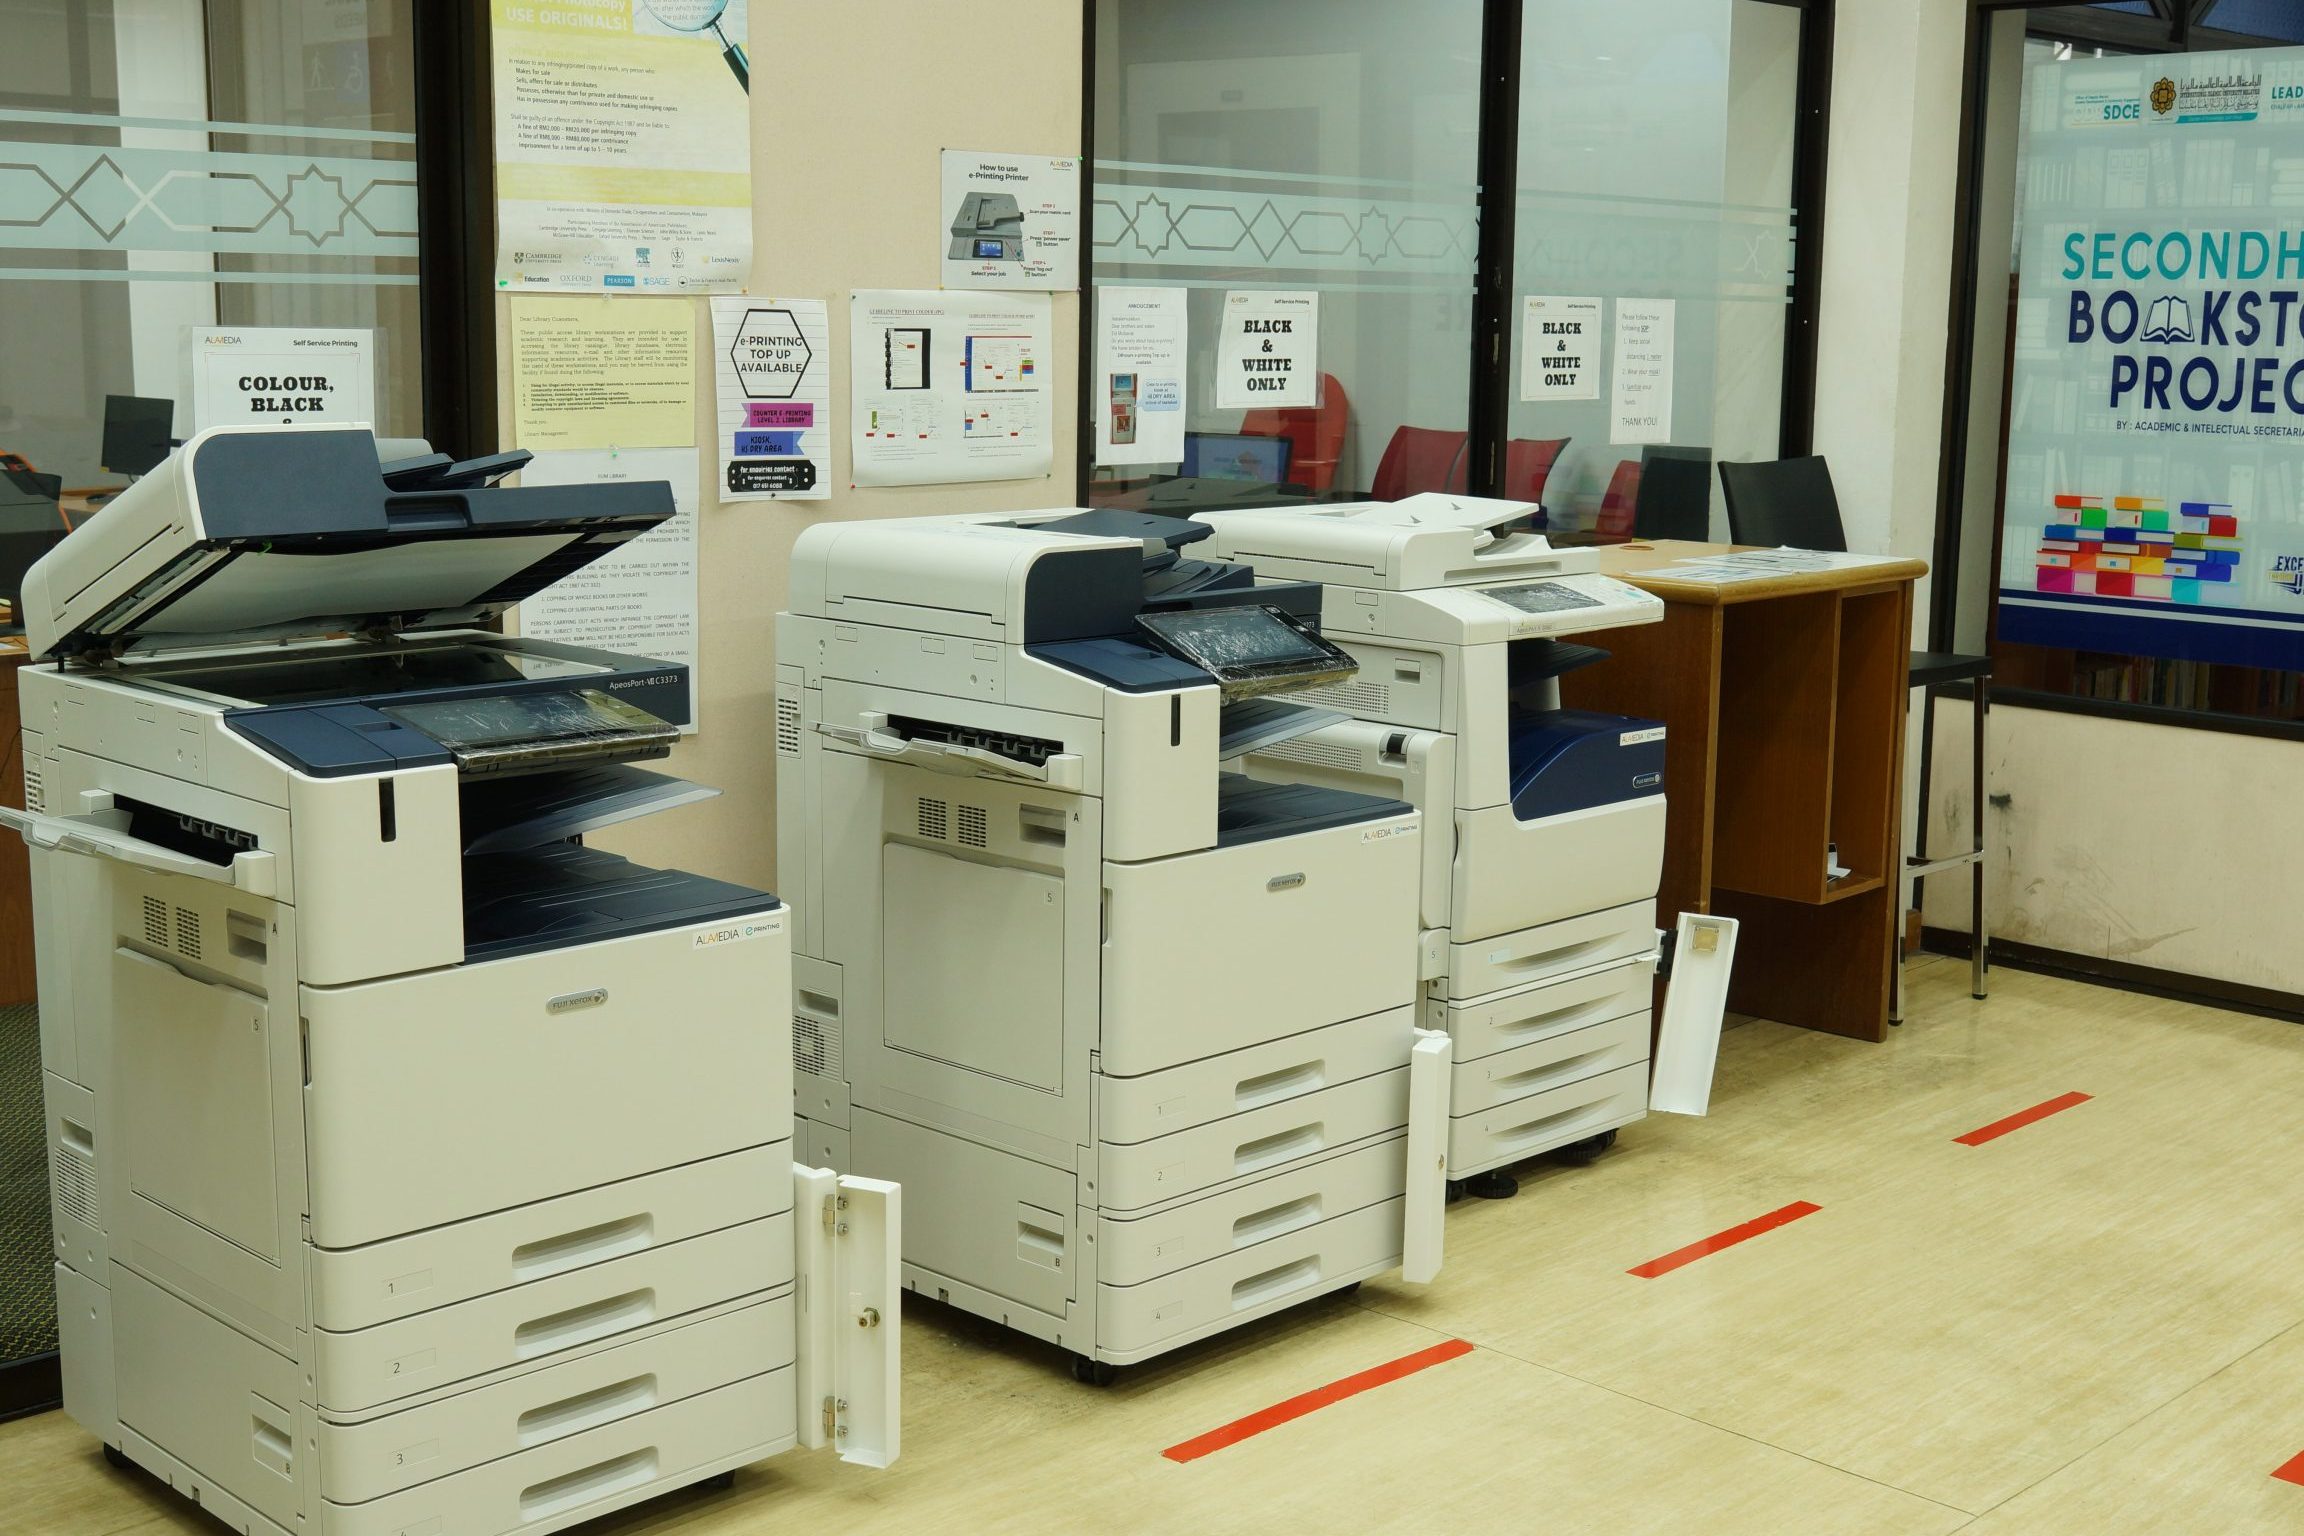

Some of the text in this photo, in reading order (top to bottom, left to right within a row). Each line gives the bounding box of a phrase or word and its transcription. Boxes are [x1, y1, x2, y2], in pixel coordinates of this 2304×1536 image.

[507, 7, 627, 31] USE ORIGINALS!
[620, 103, 638, 111] making
[639, 104, 662, 112] infringing
[2104, 104, 2140, 119] SDCE
[980, 164, 996, 172] How
[969, 173, 1004, 181] e-Printing
[650, 277, 670, 285] SAGE
[1243, 320, 1292, 333] BLACK
[1542, 323, 1582, 334] BLACK
[205, 336, 242, 344] ALAMEDIA
[740, 336, 803, 347] e-PRINTING
[1262, 339, 1273, 352] &
[1557, 340, 1566, 351] &
[751, 349, 791, 359] TOP UP
[741, 363, 803, 373] AVAILABLE
[1242, 358, 1292, 372] WHITE
[1542, 357, 1581, 368] WHITE
[239, 376, 334, 392] COLOUR,
[1246, 378, 1287, 391] ONLY
[1545, 374, 1576, 385] ONLY
[251, 398, 324, 411] BLACK
[1622, 417, 1657, 426] THANK YOU!
[2116, 421, 2127, 430] BY
[2135, 422, 2181, 432] ACADEMIC
[2184, 424, 2189, 432] &
[2192, 424, 2250, 435] INTELECTUAL
[656, 675, 678, 685] C3373
[1074, 813, 1079, 822] A
[1047, 893, 1052, 903] 5
[272, 922, 278, 935] A
[696, 929, 739, 946] ALAMEDIA
[1431, 951, 1436, 959] 5
[254, 1019, 259, 1031] 5
[1157, 1105, 1162, 1114] 1
[1158, 1172, 1163, 1181] 2
[1156, 1246, 1161, 1257] 3
[1055, 1257, 1060, 1267] B
[388, 1282, 394, 1294] 1
[1156, 1311, 1161, 1320] 4
[393, 1362, 400, 1373] 2
[396, 1453, 403, 1465] 3
